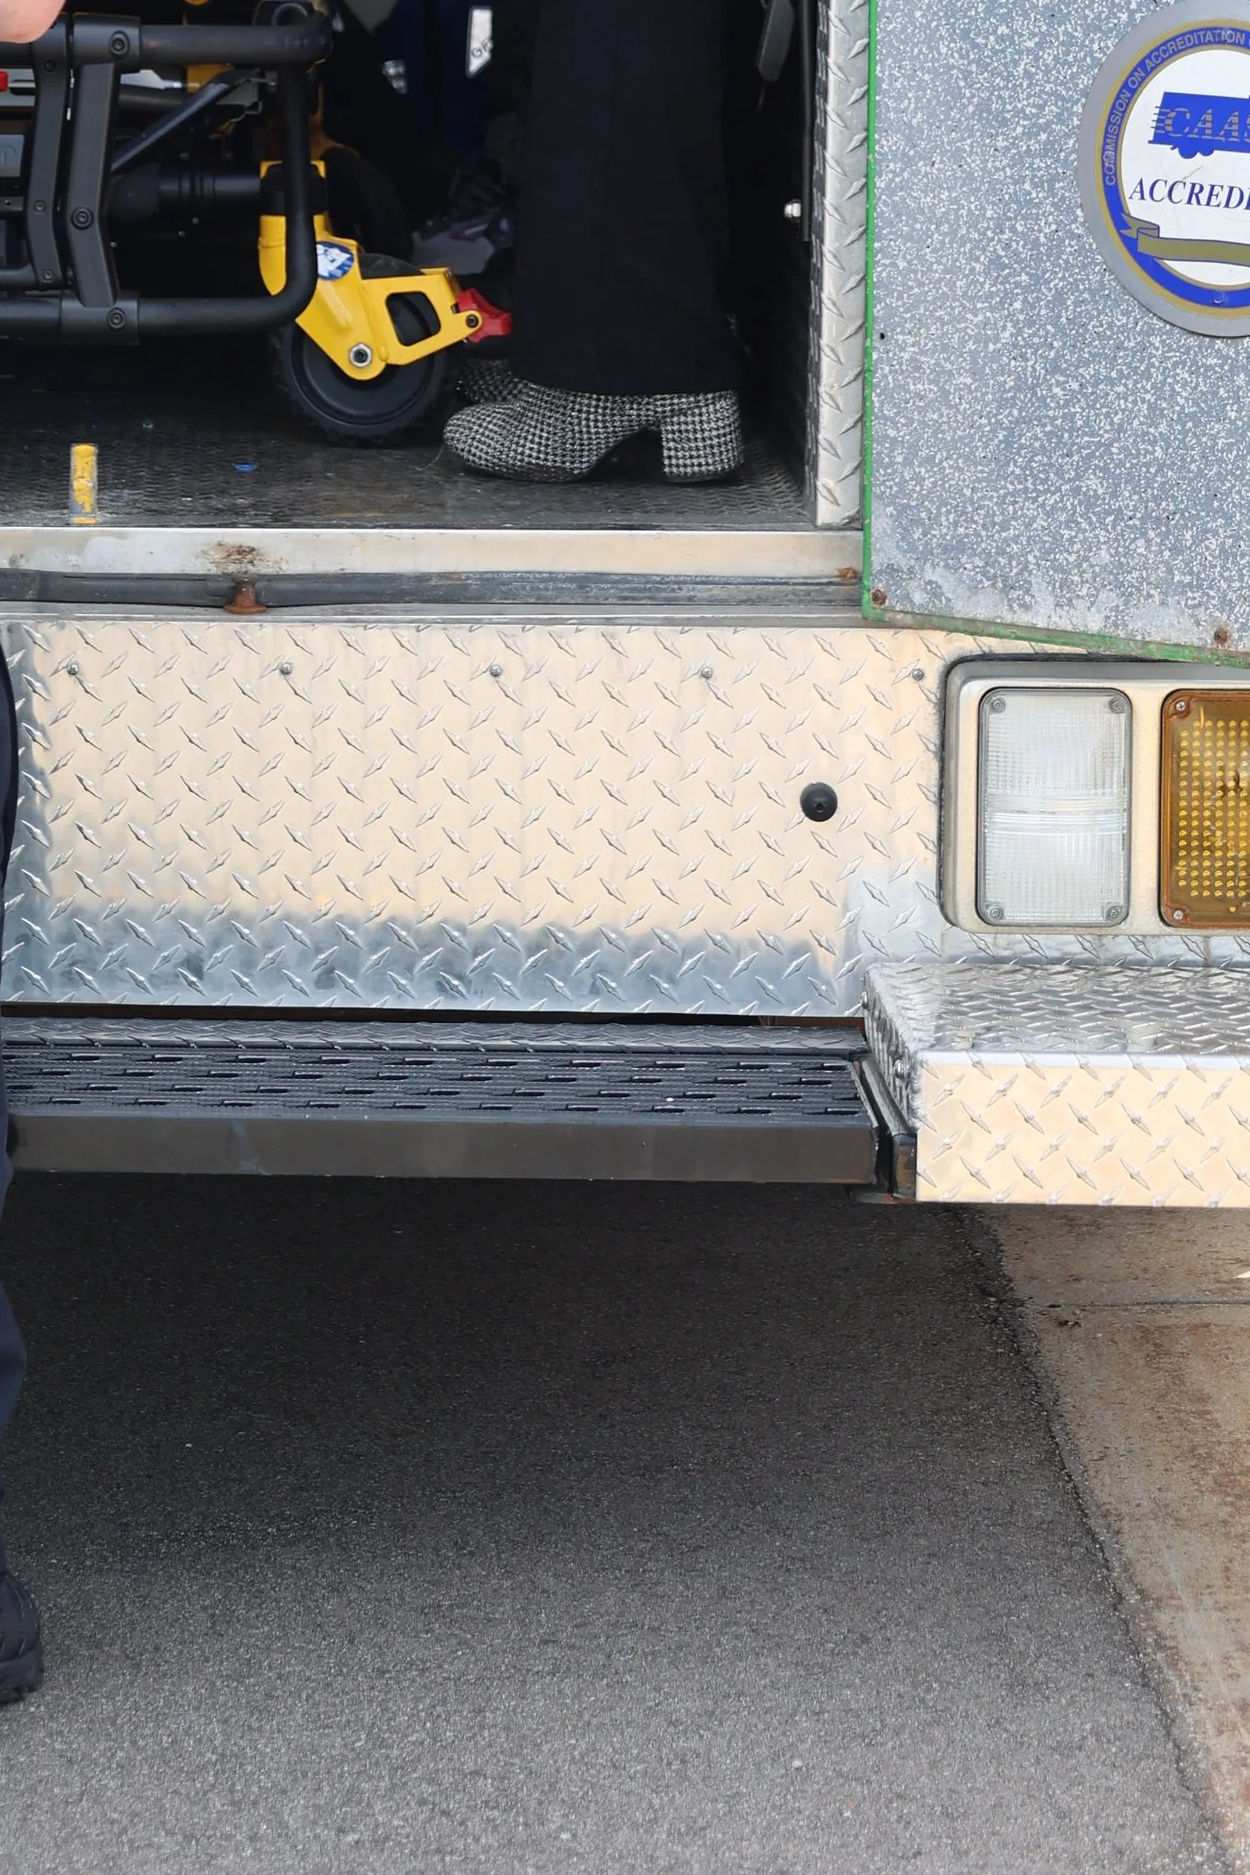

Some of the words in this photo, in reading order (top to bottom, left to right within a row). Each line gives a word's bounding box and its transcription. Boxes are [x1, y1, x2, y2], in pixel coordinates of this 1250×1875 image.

[1103, 89, 1132, 186] COMMISSION
[1128, 67, 1146, 90] ON
[1144, 30, 1245, 72] ACCREDITATION
